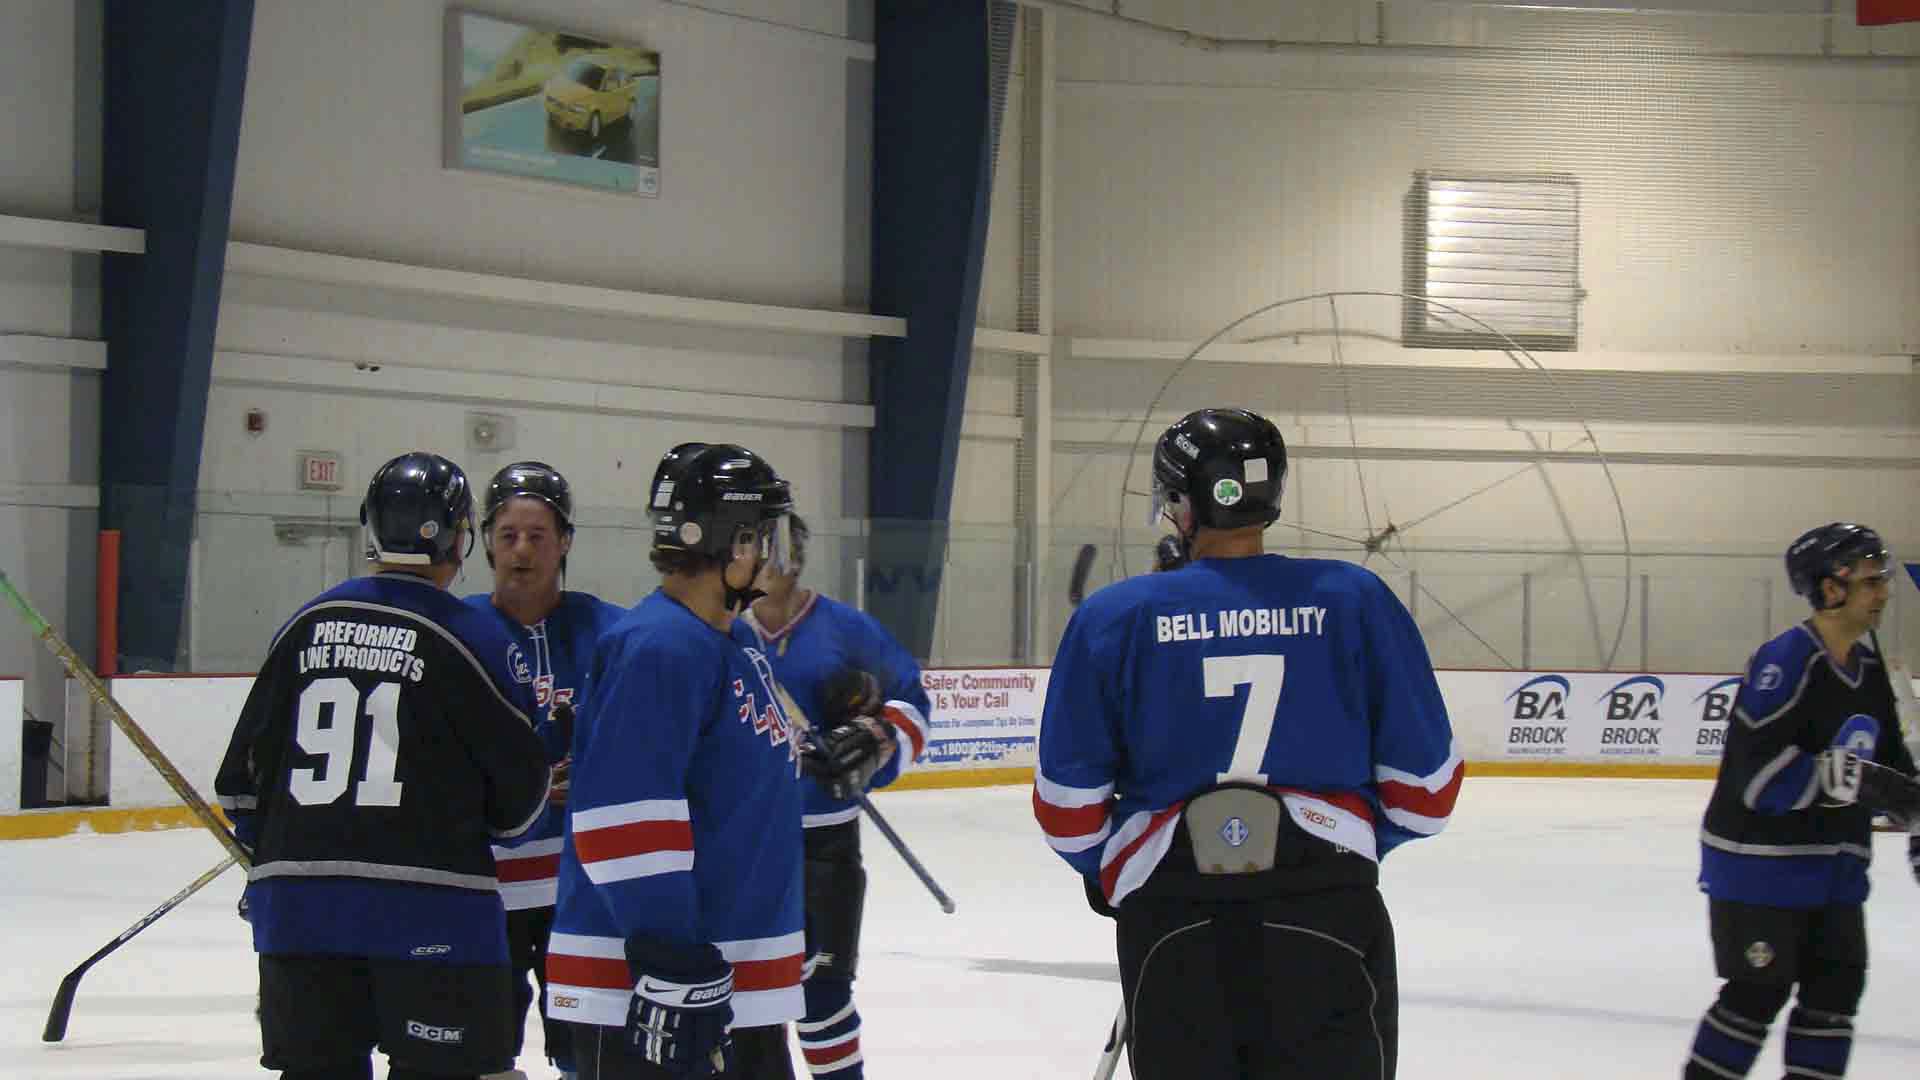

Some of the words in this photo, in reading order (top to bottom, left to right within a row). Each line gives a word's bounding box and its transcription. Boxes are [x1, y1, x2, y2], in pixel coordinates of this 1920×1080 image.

[311, 460, 335, 481] EXIT
[313, 621, 417, 652] PREFORMED
[1156, 613, 1214, 643] BELL
[1219, 606, 1327, 638] MOBILITY
[299, 646, 331, 675] LINE
[333, 645, 425, 682] PRODUCTS
[923, 674, 958, 690] Safer
[961, 672, 1036, 692] Community
[936, 693, 948, 709] Is
[951, 691, 980, 709] Your
[983, 691, 1009, 709] Call
[1513, 691, 1566, 721] BA
[1606, 692, 1660, 721] BA
[1702, 692, 1731, 722] B
[1203, 654, 1285, 785] 7
[289, 677, 403, 807] 91
[1508, 727, 1568, 744] BROCK
[1601, 728, 1661, 745] BROCK
[407, 1020, 464, 1044] CCM
